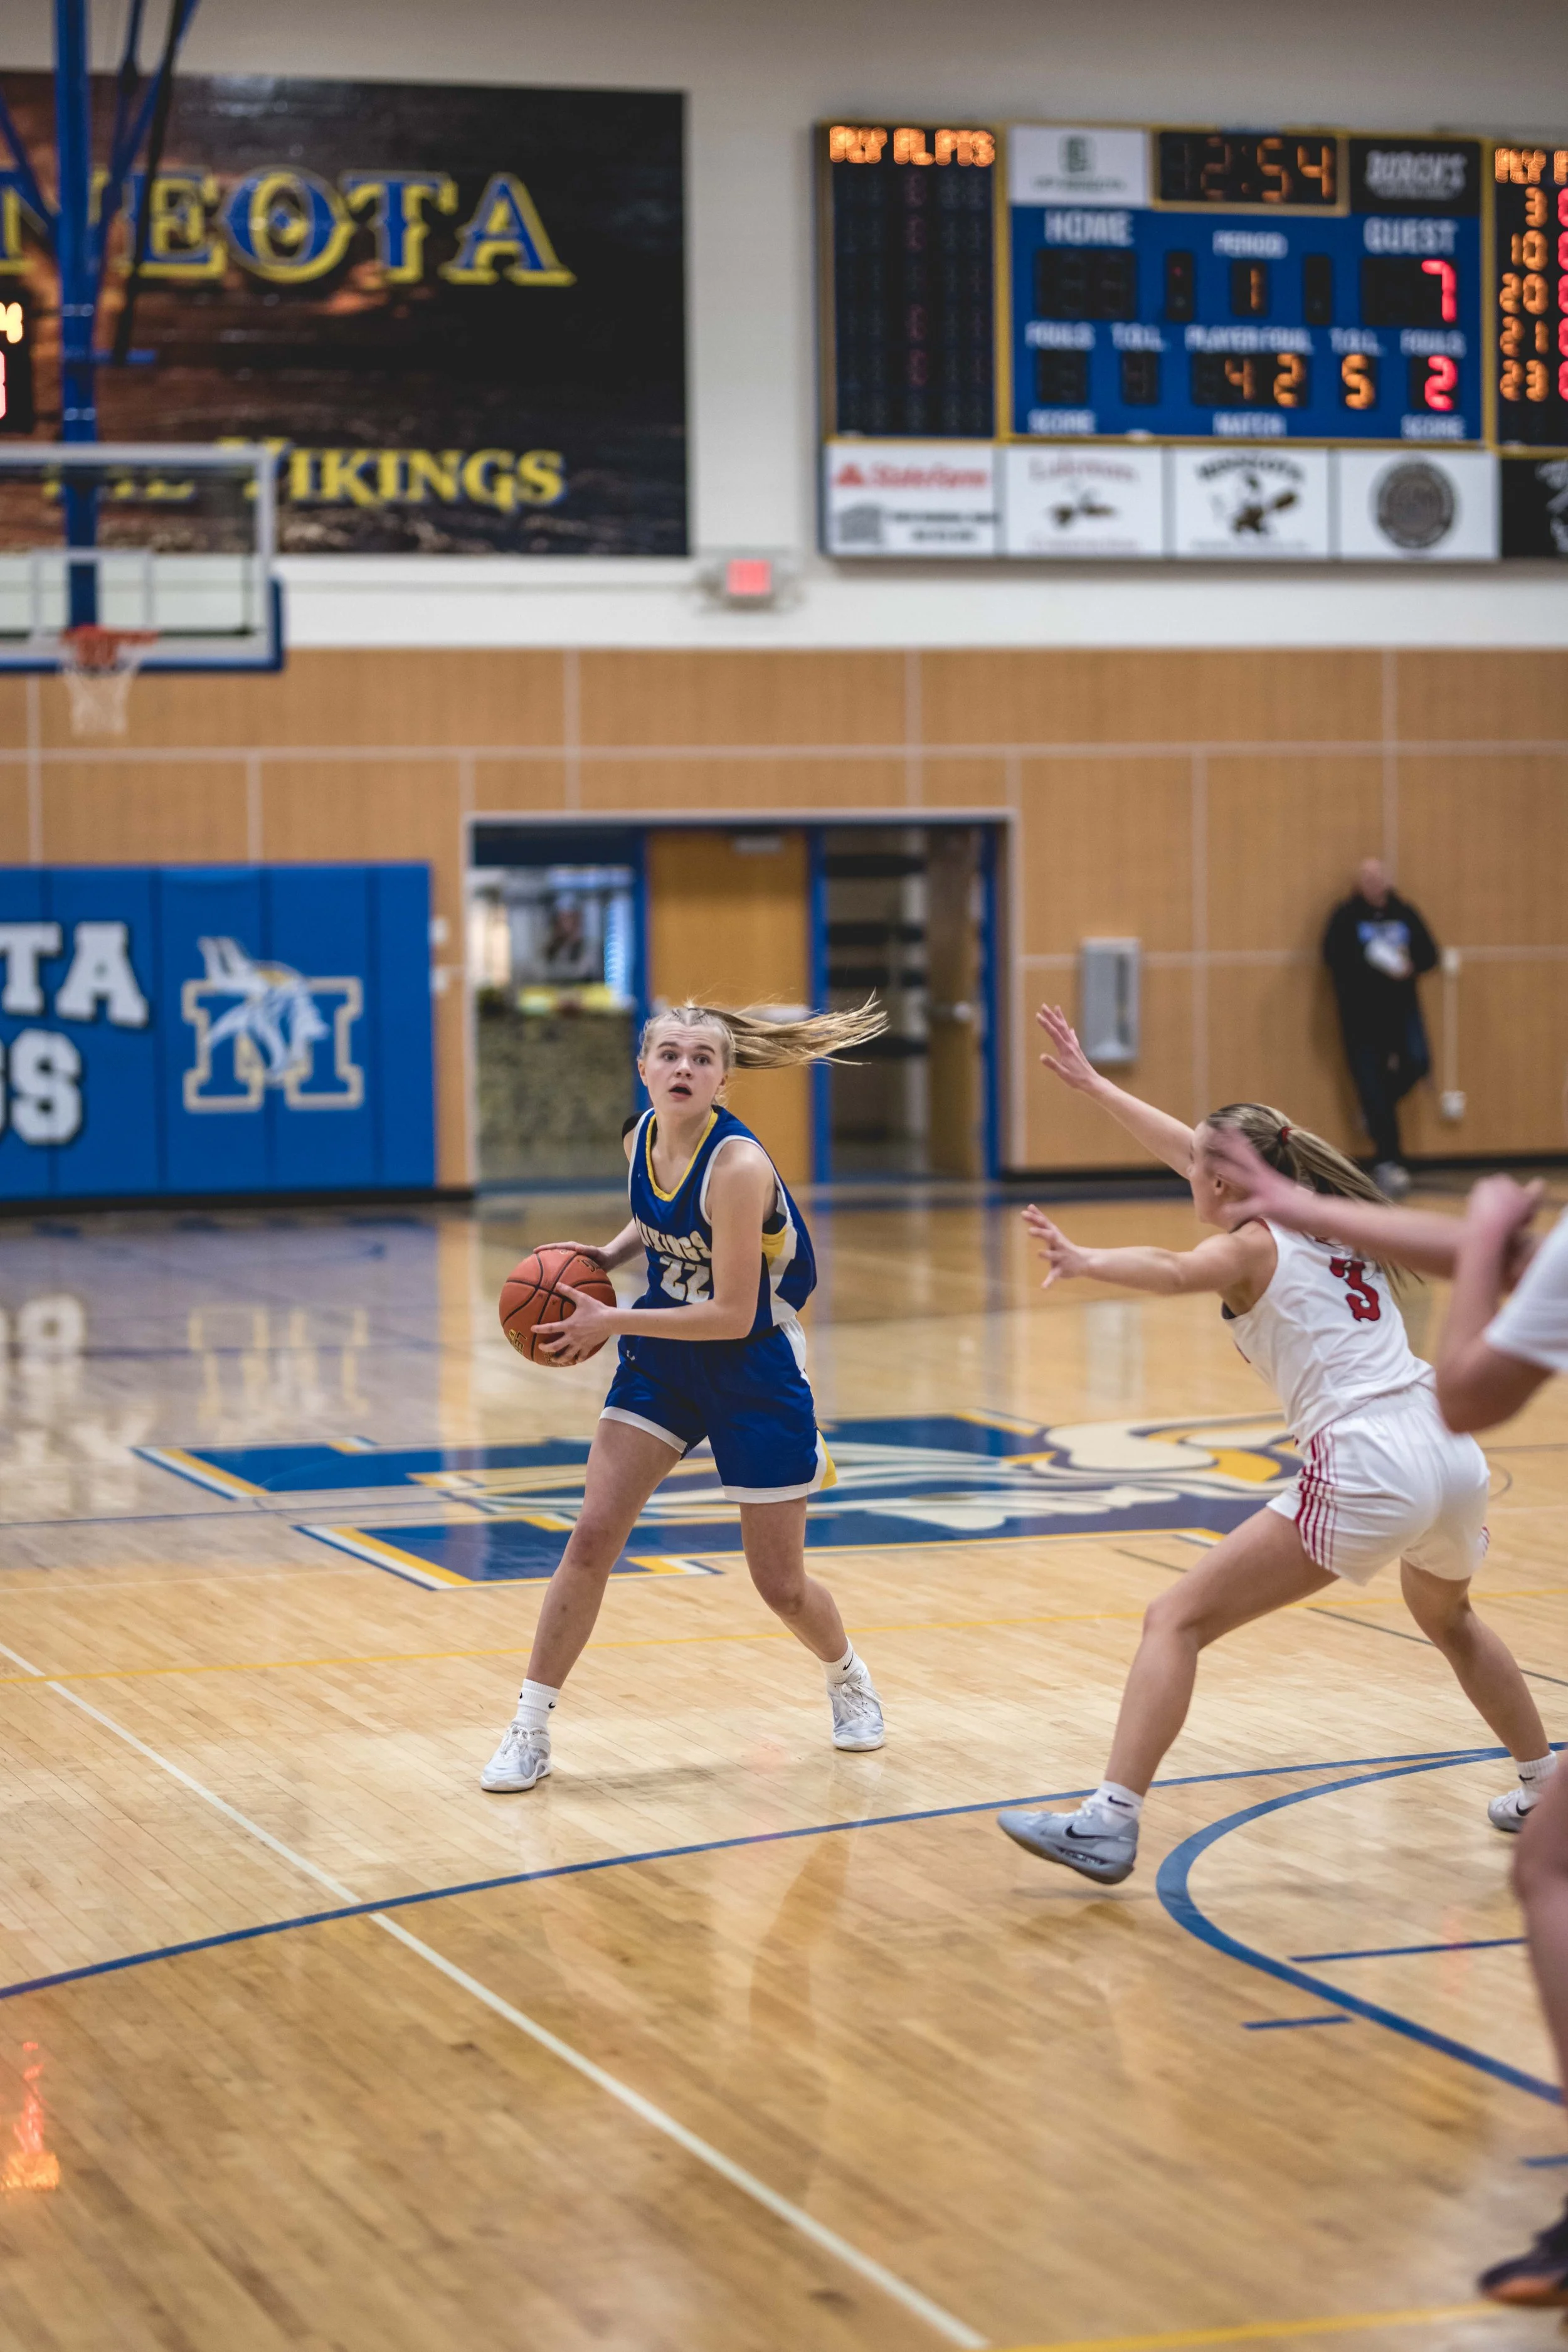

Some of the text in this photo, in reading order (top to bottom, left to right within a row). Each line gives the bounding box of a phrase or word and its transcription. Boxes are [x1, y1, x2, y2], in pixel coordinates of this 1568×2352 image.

[1525, 187, 1548, 227] 3
[1364, 217, 1459, 255] GUEST
[1512, 230, 1549, 271] 10
[1421, 260, 1457, 322] 7
[1500, 273, 1549, 314] 20
[1500, 316, 1549, 357] 21
[1225, 358, 1255, 400] 4
[1273, 353, 1306, 408] 2
[1342, 354, 1375, 410] 5
[1425, 355, 1458, 411] 2
[1500, 359, 1549, 401] 23
[0, 1028, 82, 1146] S
[659, 1255, 710, 1303] 22
[1329, 1255, 1382, 1322] 3
